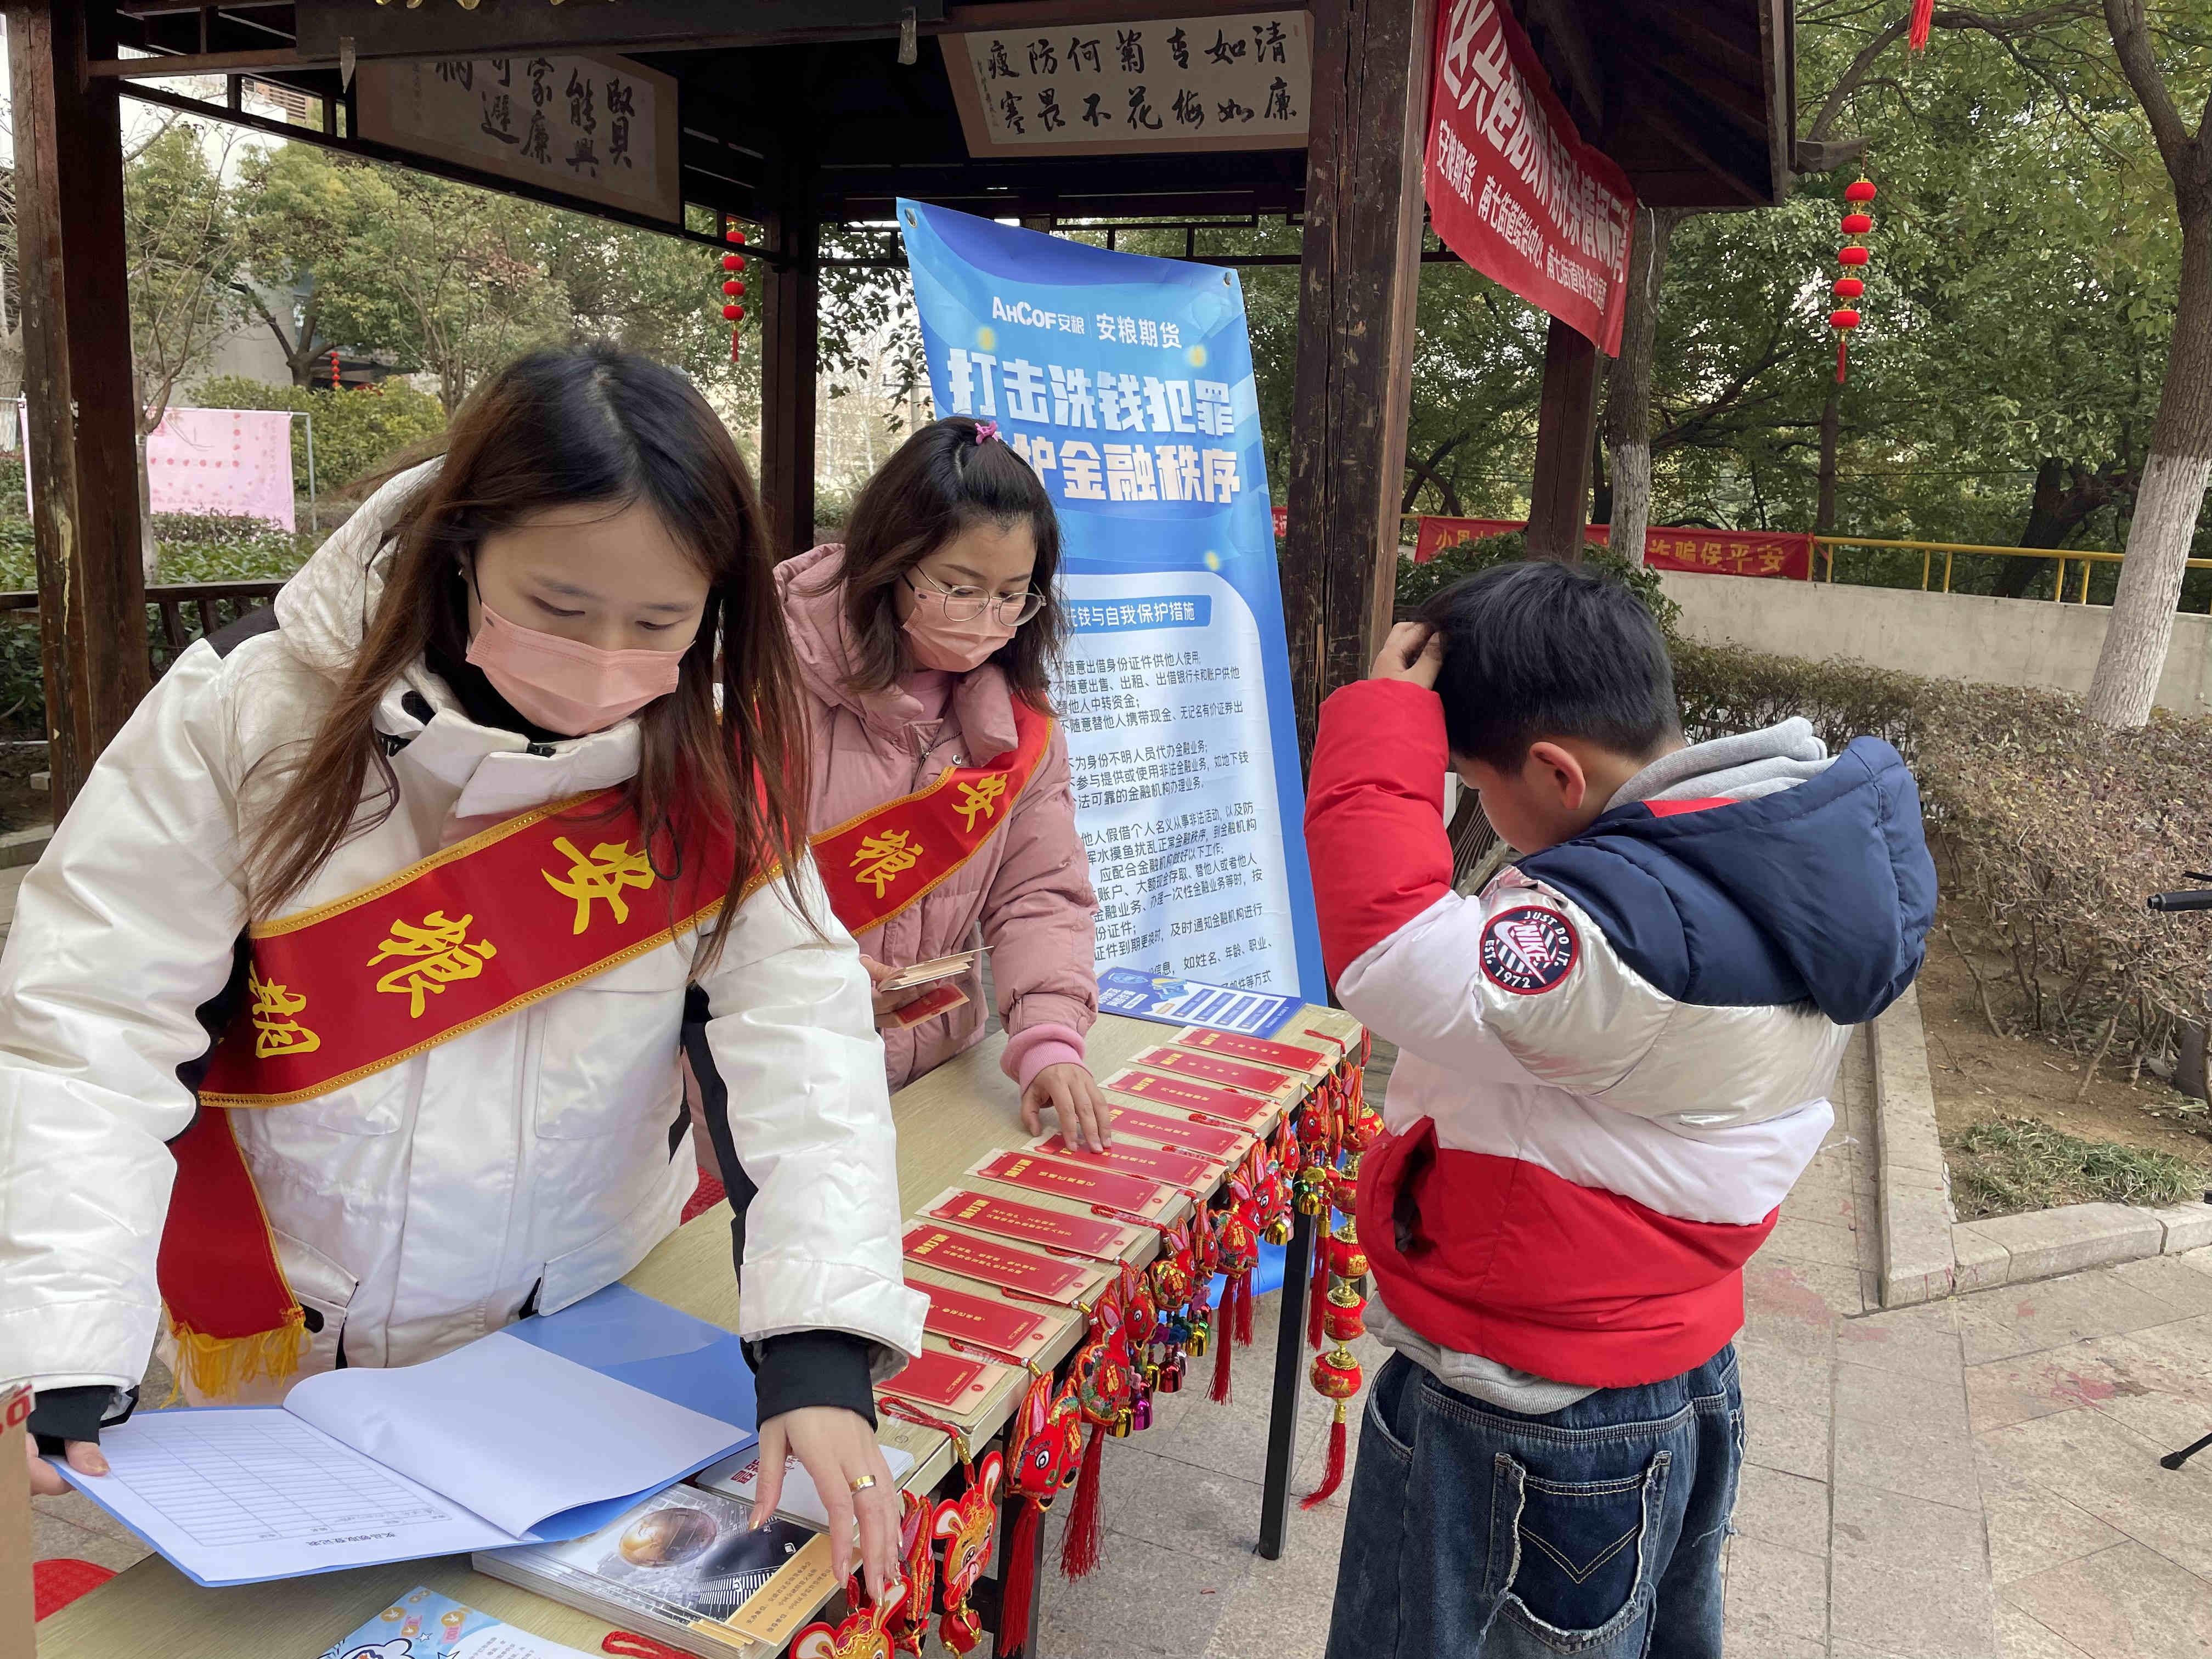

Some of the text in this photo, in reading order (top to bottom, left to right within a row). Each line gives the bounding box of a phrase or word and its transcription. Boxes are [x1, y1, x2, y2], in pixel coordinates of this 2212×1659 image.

[1096, 314, 1182, 350] 安粮期货
[947, 348, 1235, 436] 打击洗钱犯罪
[997, 431, 1241, 504] 护金融秩序
[1074, 776, 1206, 810] 法可靠的金融机构办理业务。
[849, 772, 1008, 899] 安粮
[1513, 923, 1554, 969] NIKE
[1524, 911, 1559, 926] JUST
[1555, 927, 1570, 945] DO
[1484, 939, 1531, 988] EST. 1972
